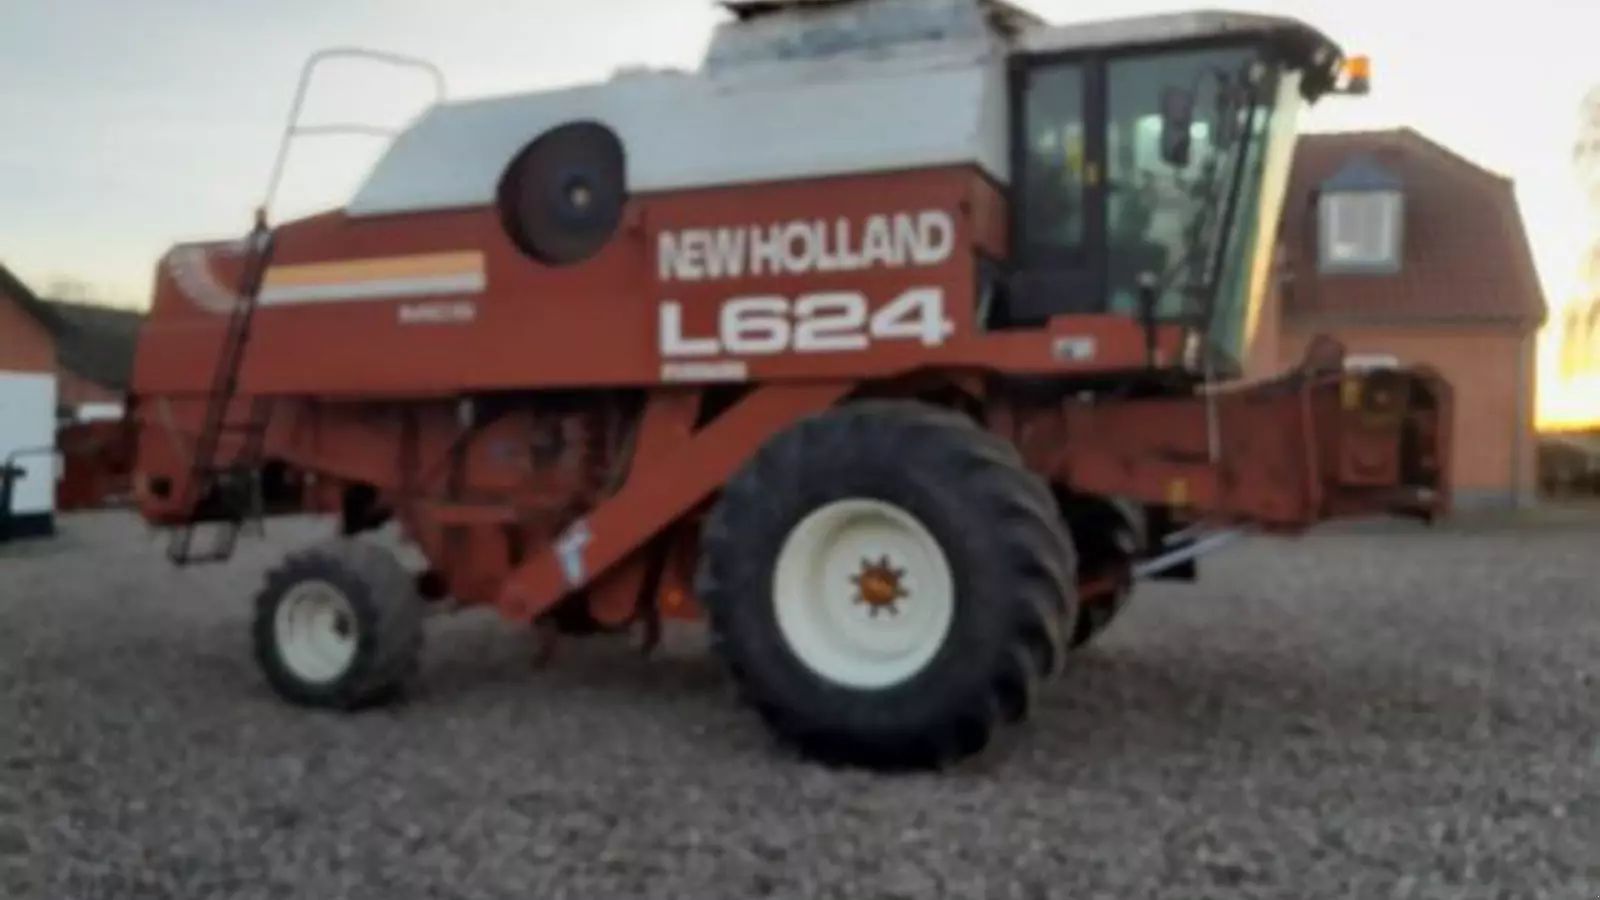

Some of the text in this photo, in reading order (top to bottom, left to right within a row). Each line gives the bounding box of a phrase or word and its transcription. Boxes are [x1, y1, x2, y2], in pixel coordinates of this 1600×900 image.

[658, 210, 954, 281] NEW HOLLAND
[659, 287, 954, 356] L624
